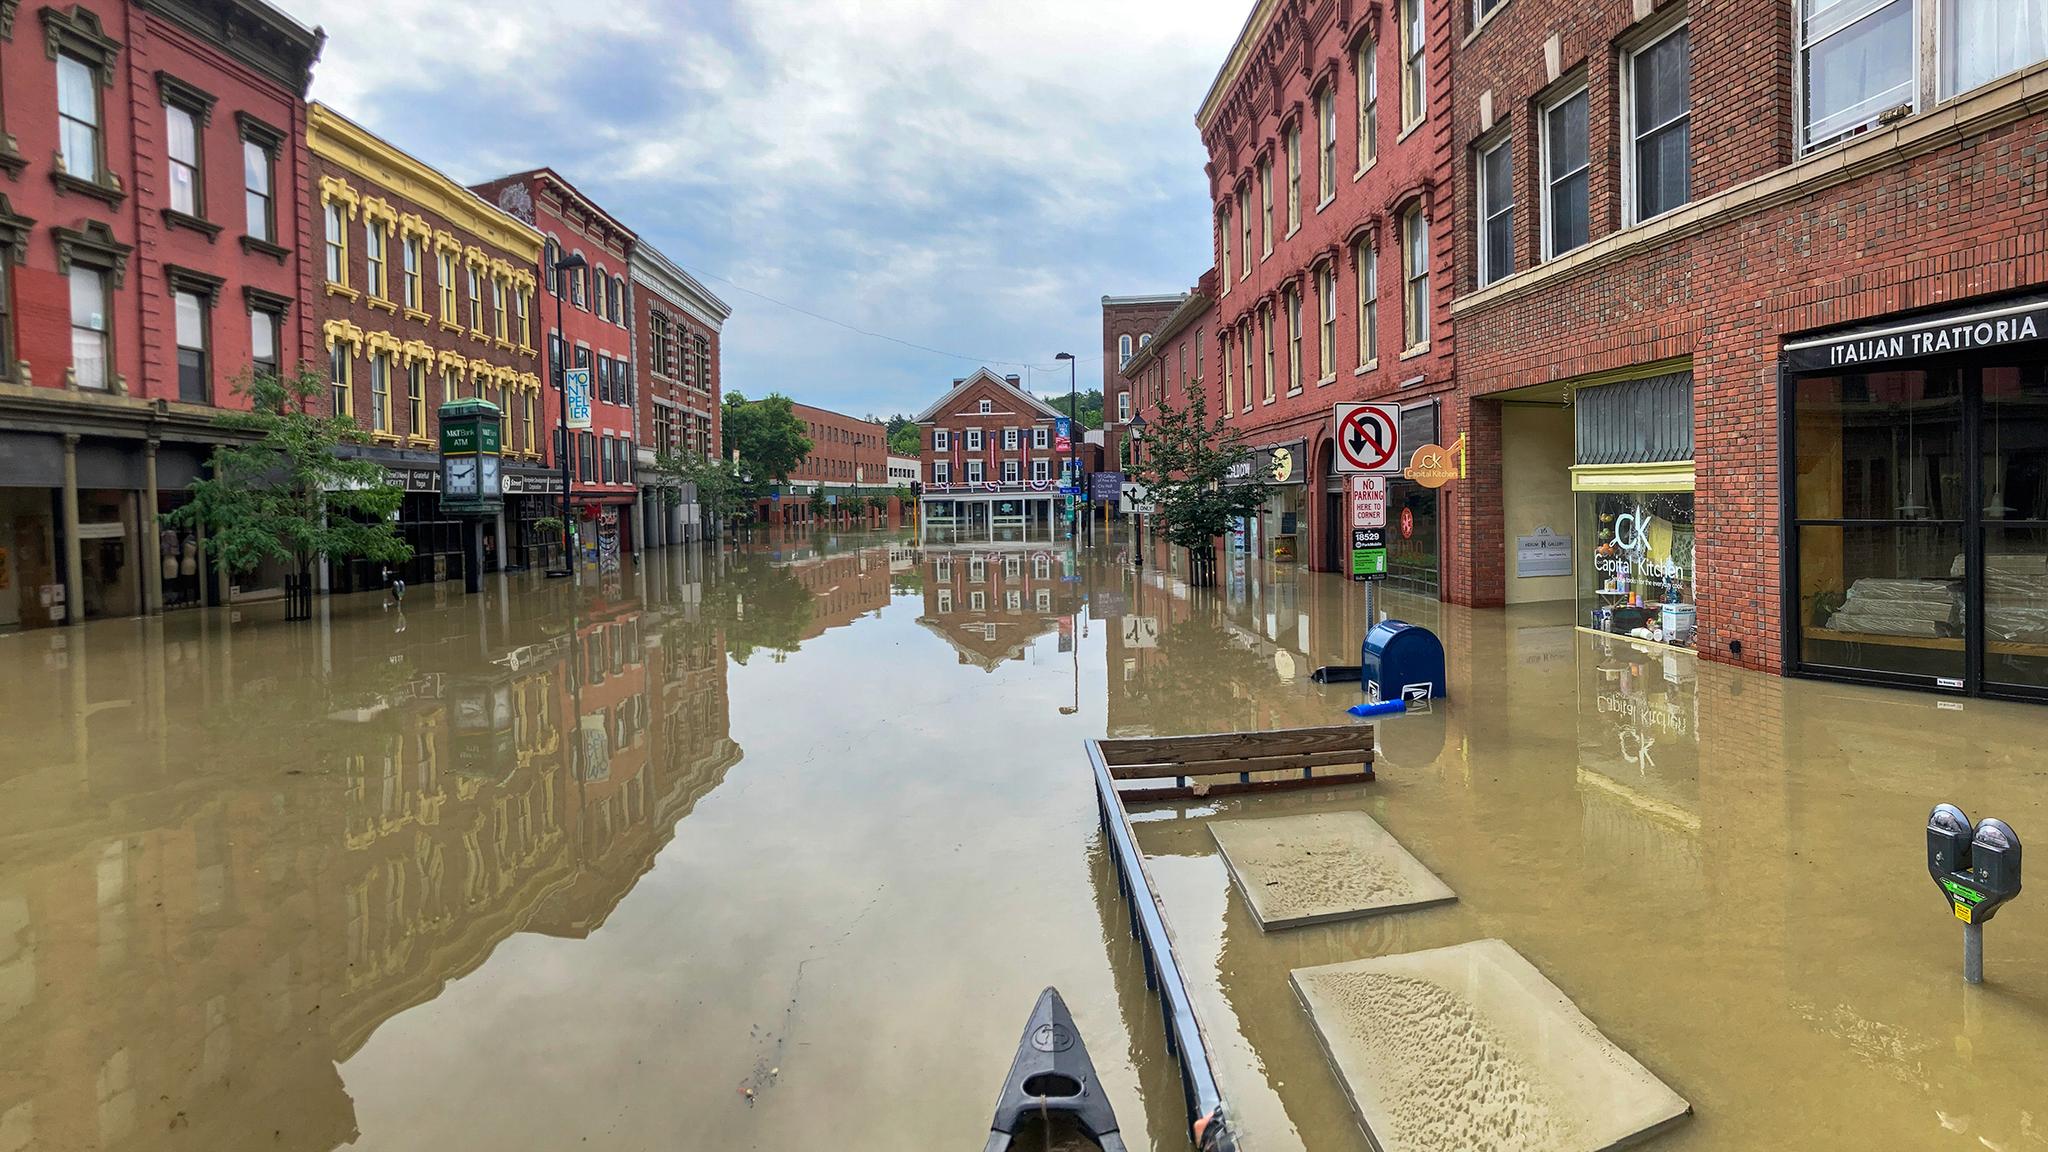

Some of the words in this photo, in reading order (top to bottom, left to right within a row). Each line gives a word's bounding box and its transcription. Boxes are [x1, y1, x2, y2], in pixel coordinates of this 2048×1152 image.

[1831, 336, 1904, 365] ITALIAN
[1911, 316, 2038, 355] TRATTORIA
[1407, 470, 1431, 478] Capital
[1432, 470, 1457, 478] Kitchen
[1362, 480, 1374, 490] NO
[1354, 491, 1383, 500] PARKING
[1357, 503, 1373, 511] HERE
[1355, 533, 1380, 541] 18529
[1595, 553, 1632, 576] Capital
[1638, 558, 1684, 580] Kitchen
